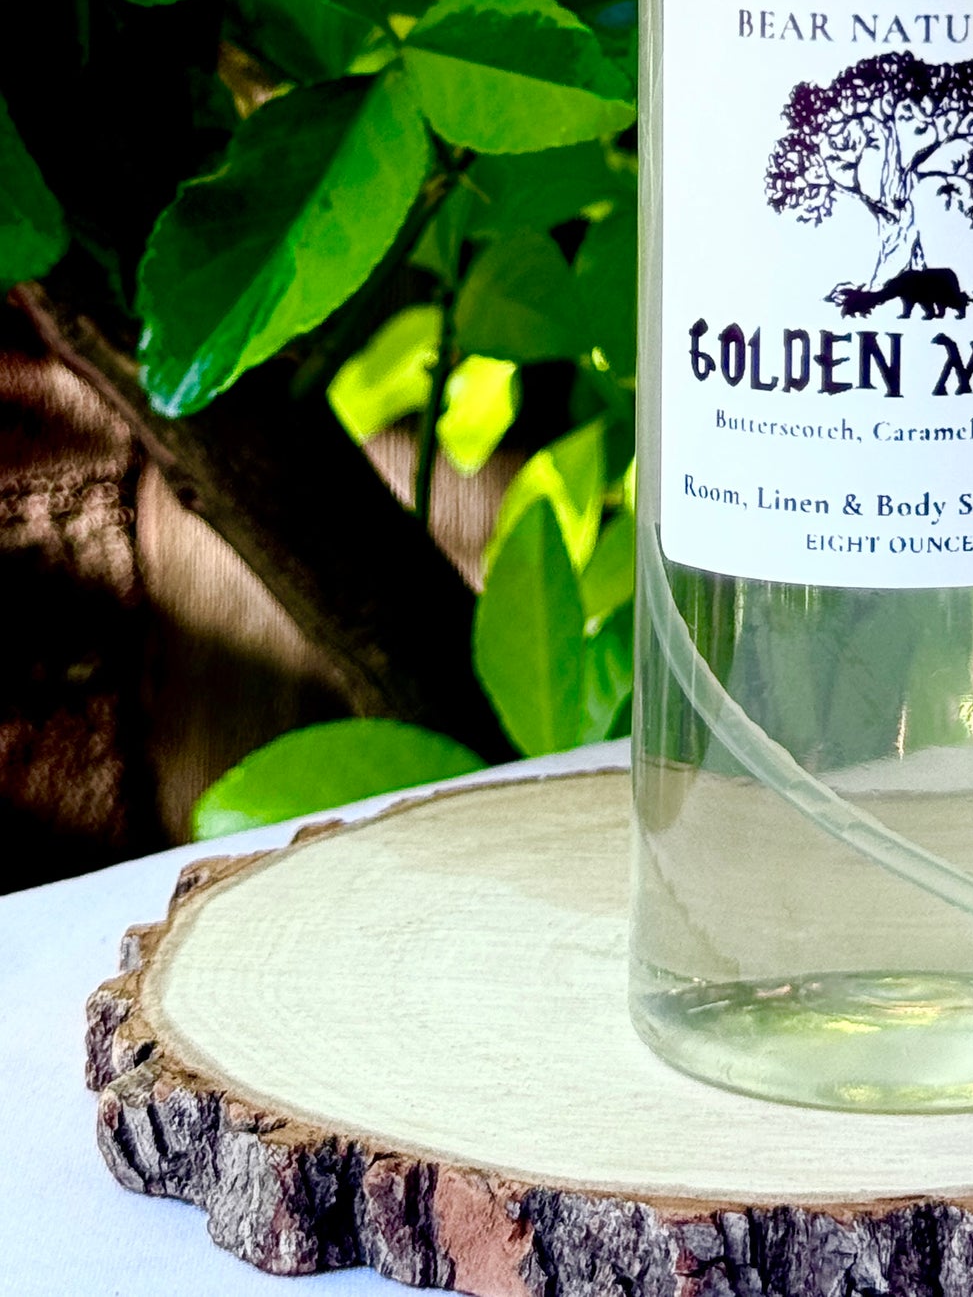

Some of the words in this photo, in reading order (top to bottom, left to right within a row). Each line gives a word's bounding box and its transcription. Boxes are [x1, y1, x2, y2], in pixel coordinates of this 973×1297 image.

[738, 8, 834, 42] BEAR
[688, 318, 904, 399] GOLDEN
[715, 408, 863, 443] Butterscotch,
[684, 473, 748, 510] Room,
[757, 486, 830, 514] Linen
[841, 493, 864, 516] &
[876, 491, 947, 525] Body
[806, 533, 881, 554] EIGHT
